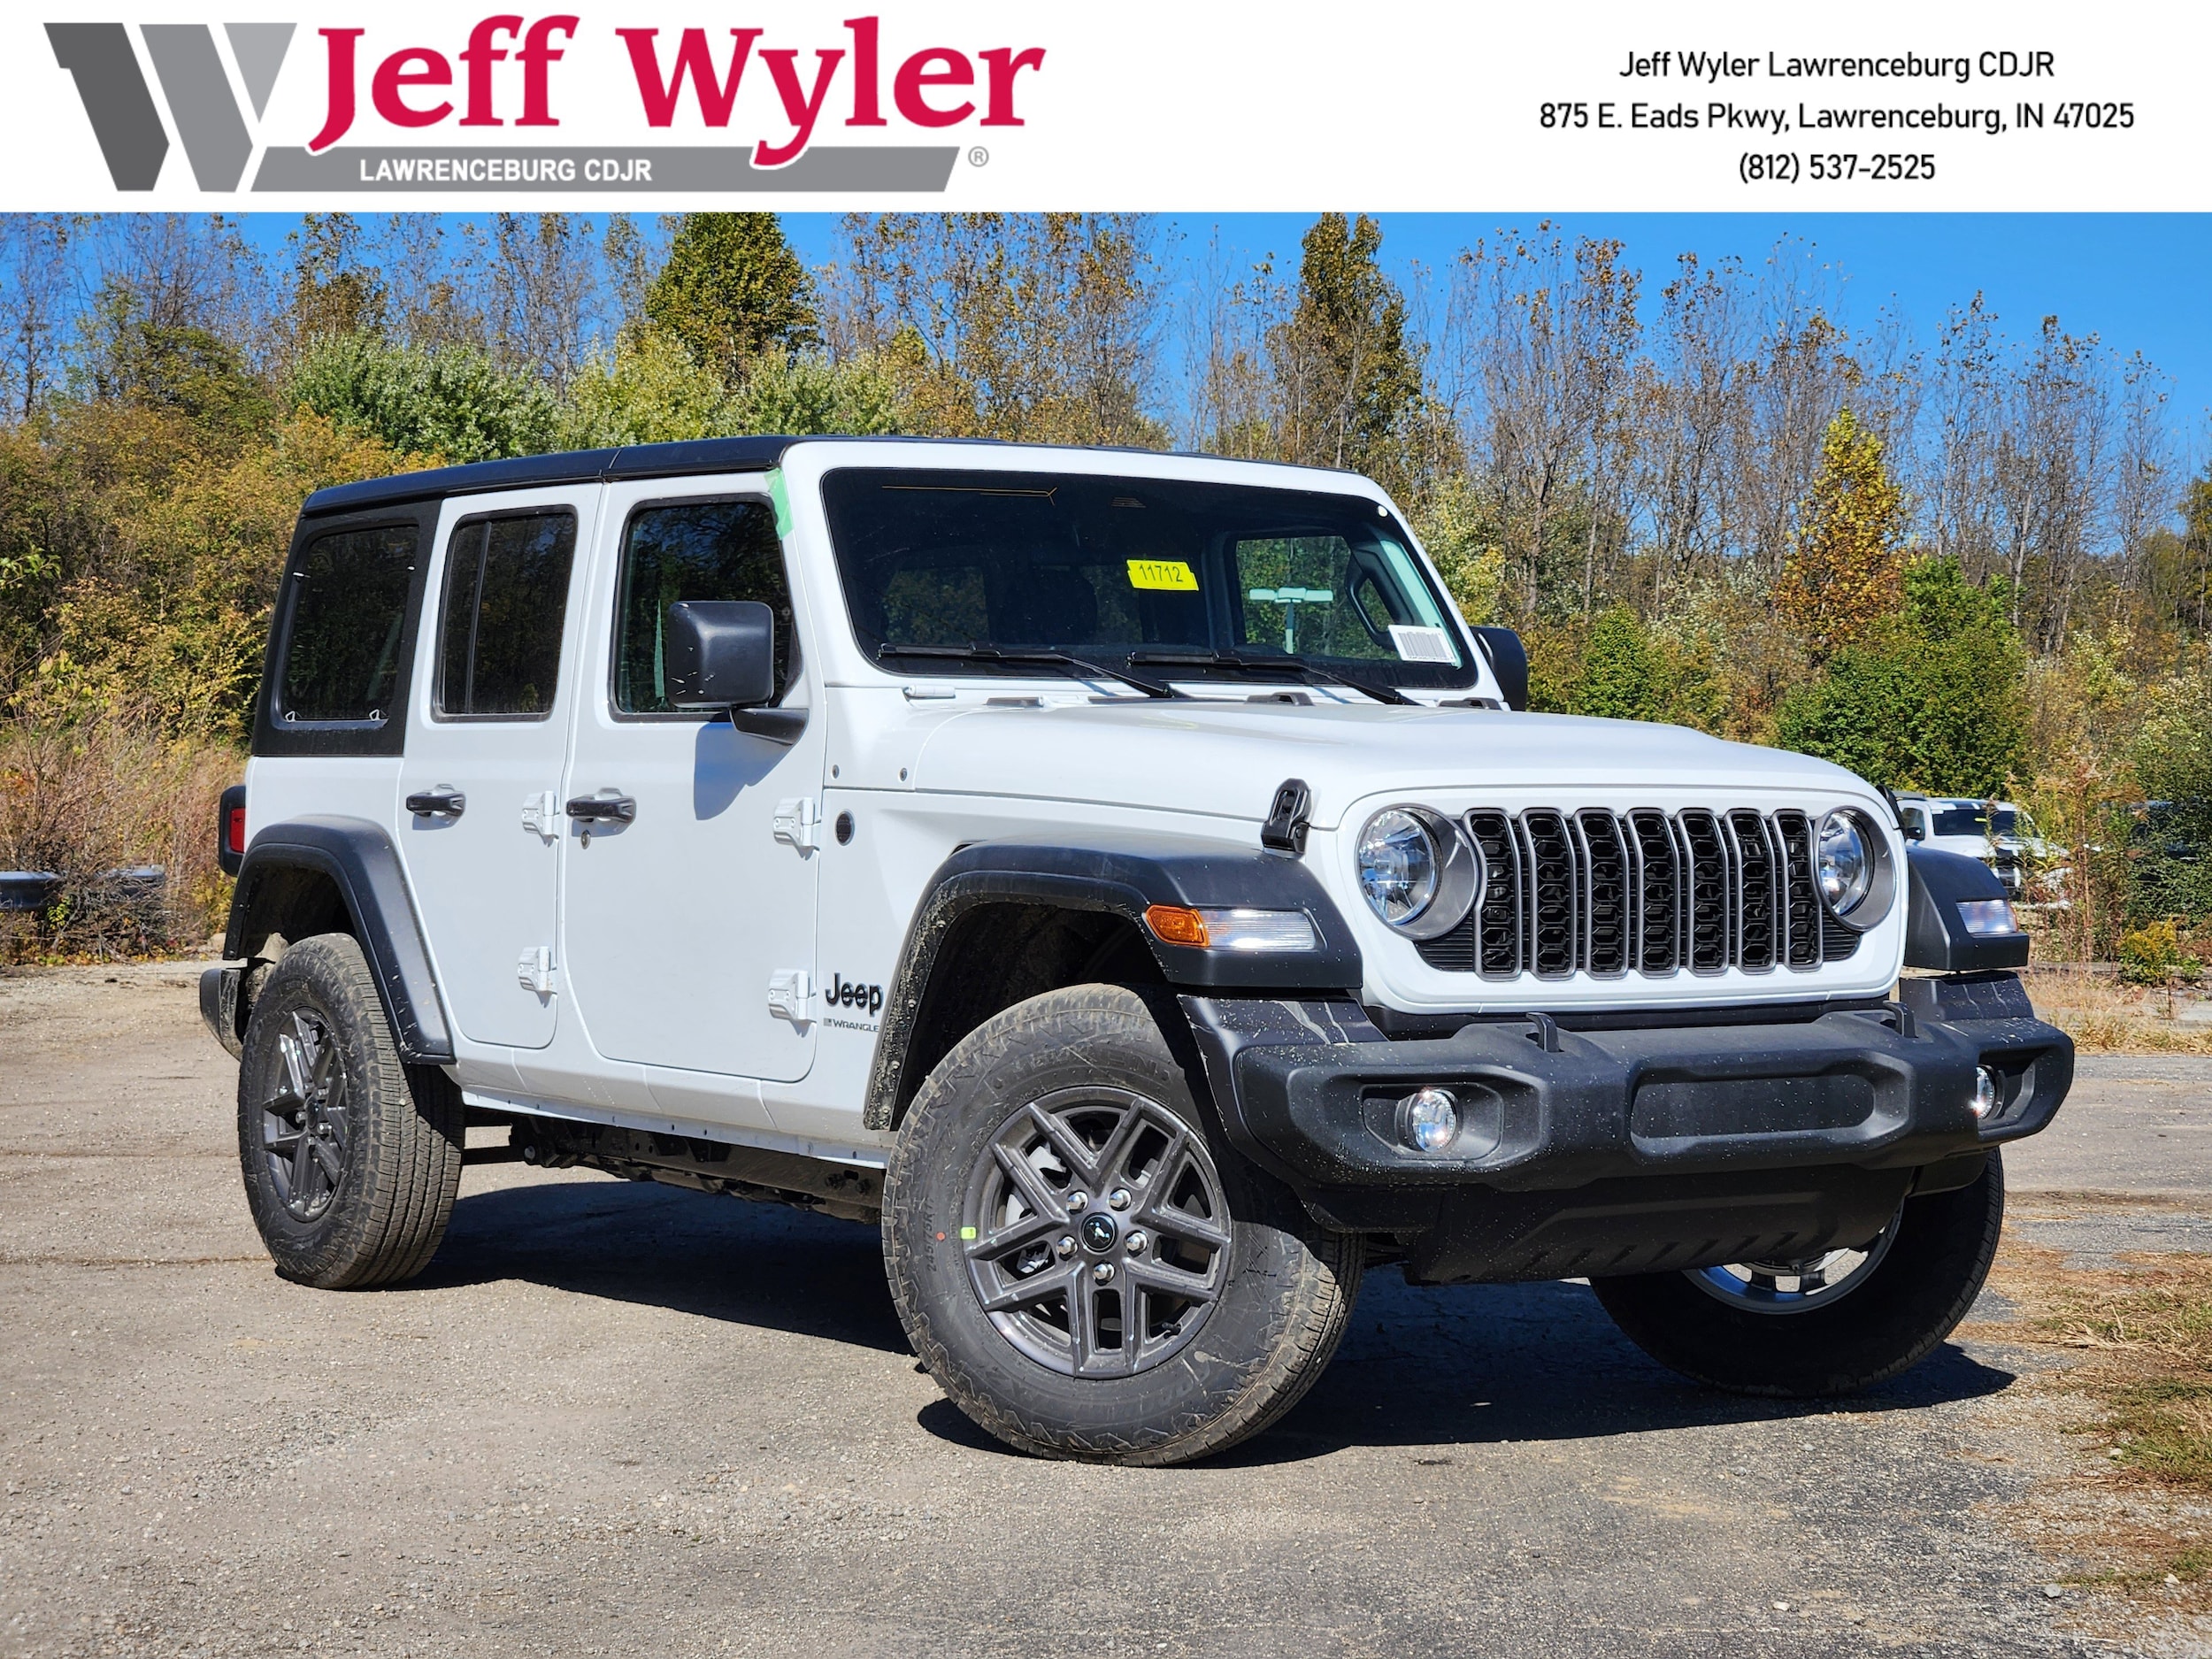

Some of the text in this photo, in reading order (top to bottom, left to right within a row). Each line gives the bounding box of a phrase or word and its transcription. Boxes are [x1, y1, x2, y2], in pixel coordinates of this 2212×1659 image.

[1139, 563, 1184, 583] 11712
[825, 972, 884, 1018] Jeep
[833, 1019, 880, 1033] WRANGLE
